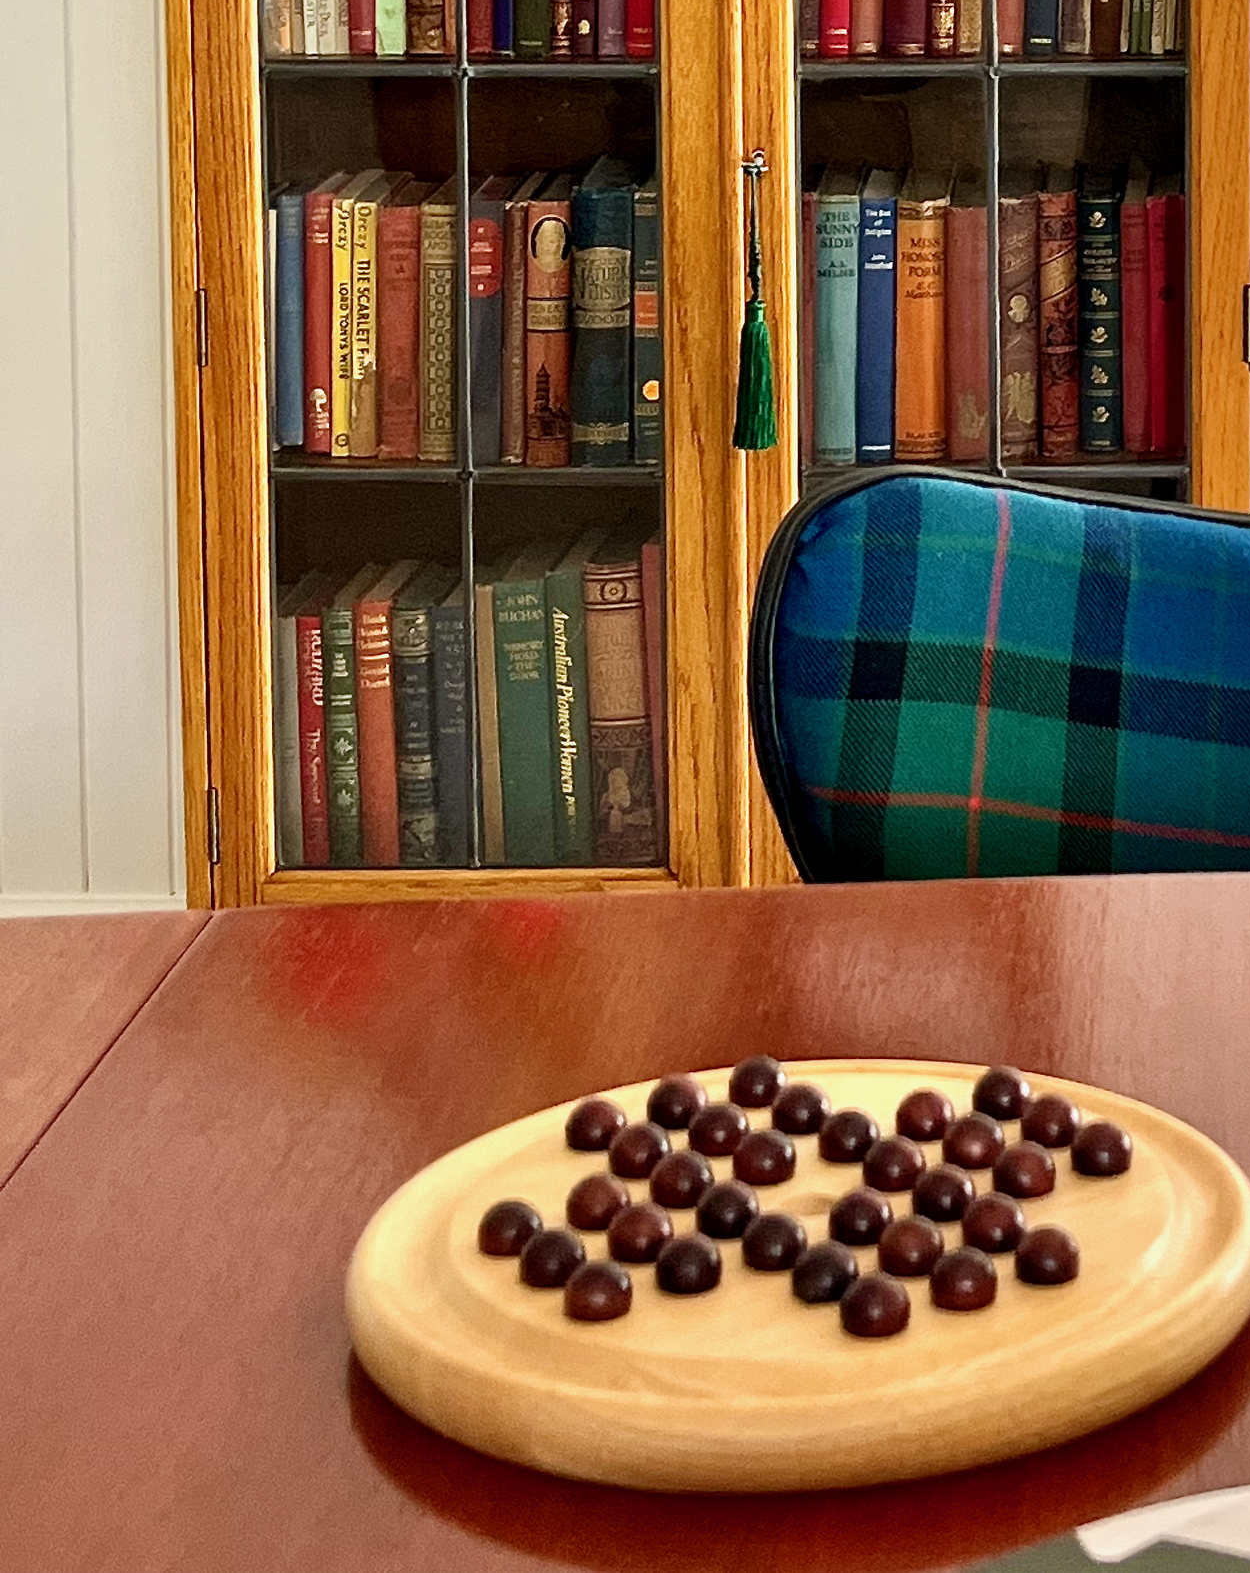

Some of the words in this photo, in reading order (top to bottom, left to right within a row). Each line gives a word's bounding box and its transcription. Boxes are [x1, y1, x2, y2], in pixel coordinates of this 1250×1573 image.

[353, 205, 373, 250] Orczy
[815, 223, 860, 235] SUNNY
[822, 211, 850, 223] THE
[820, 237, 853, 248] SIDE
[355, 259, 371, 283] THE
[816, 269, 856, 278] MILNE
[337, 281, 350, 311] LORD
[354, 286, 371, 344] SCARLET
[552, 607, 573, 684] Australian
[556, 684, 574, 741] Pioneer
[559, 740, 578, 793] Women
